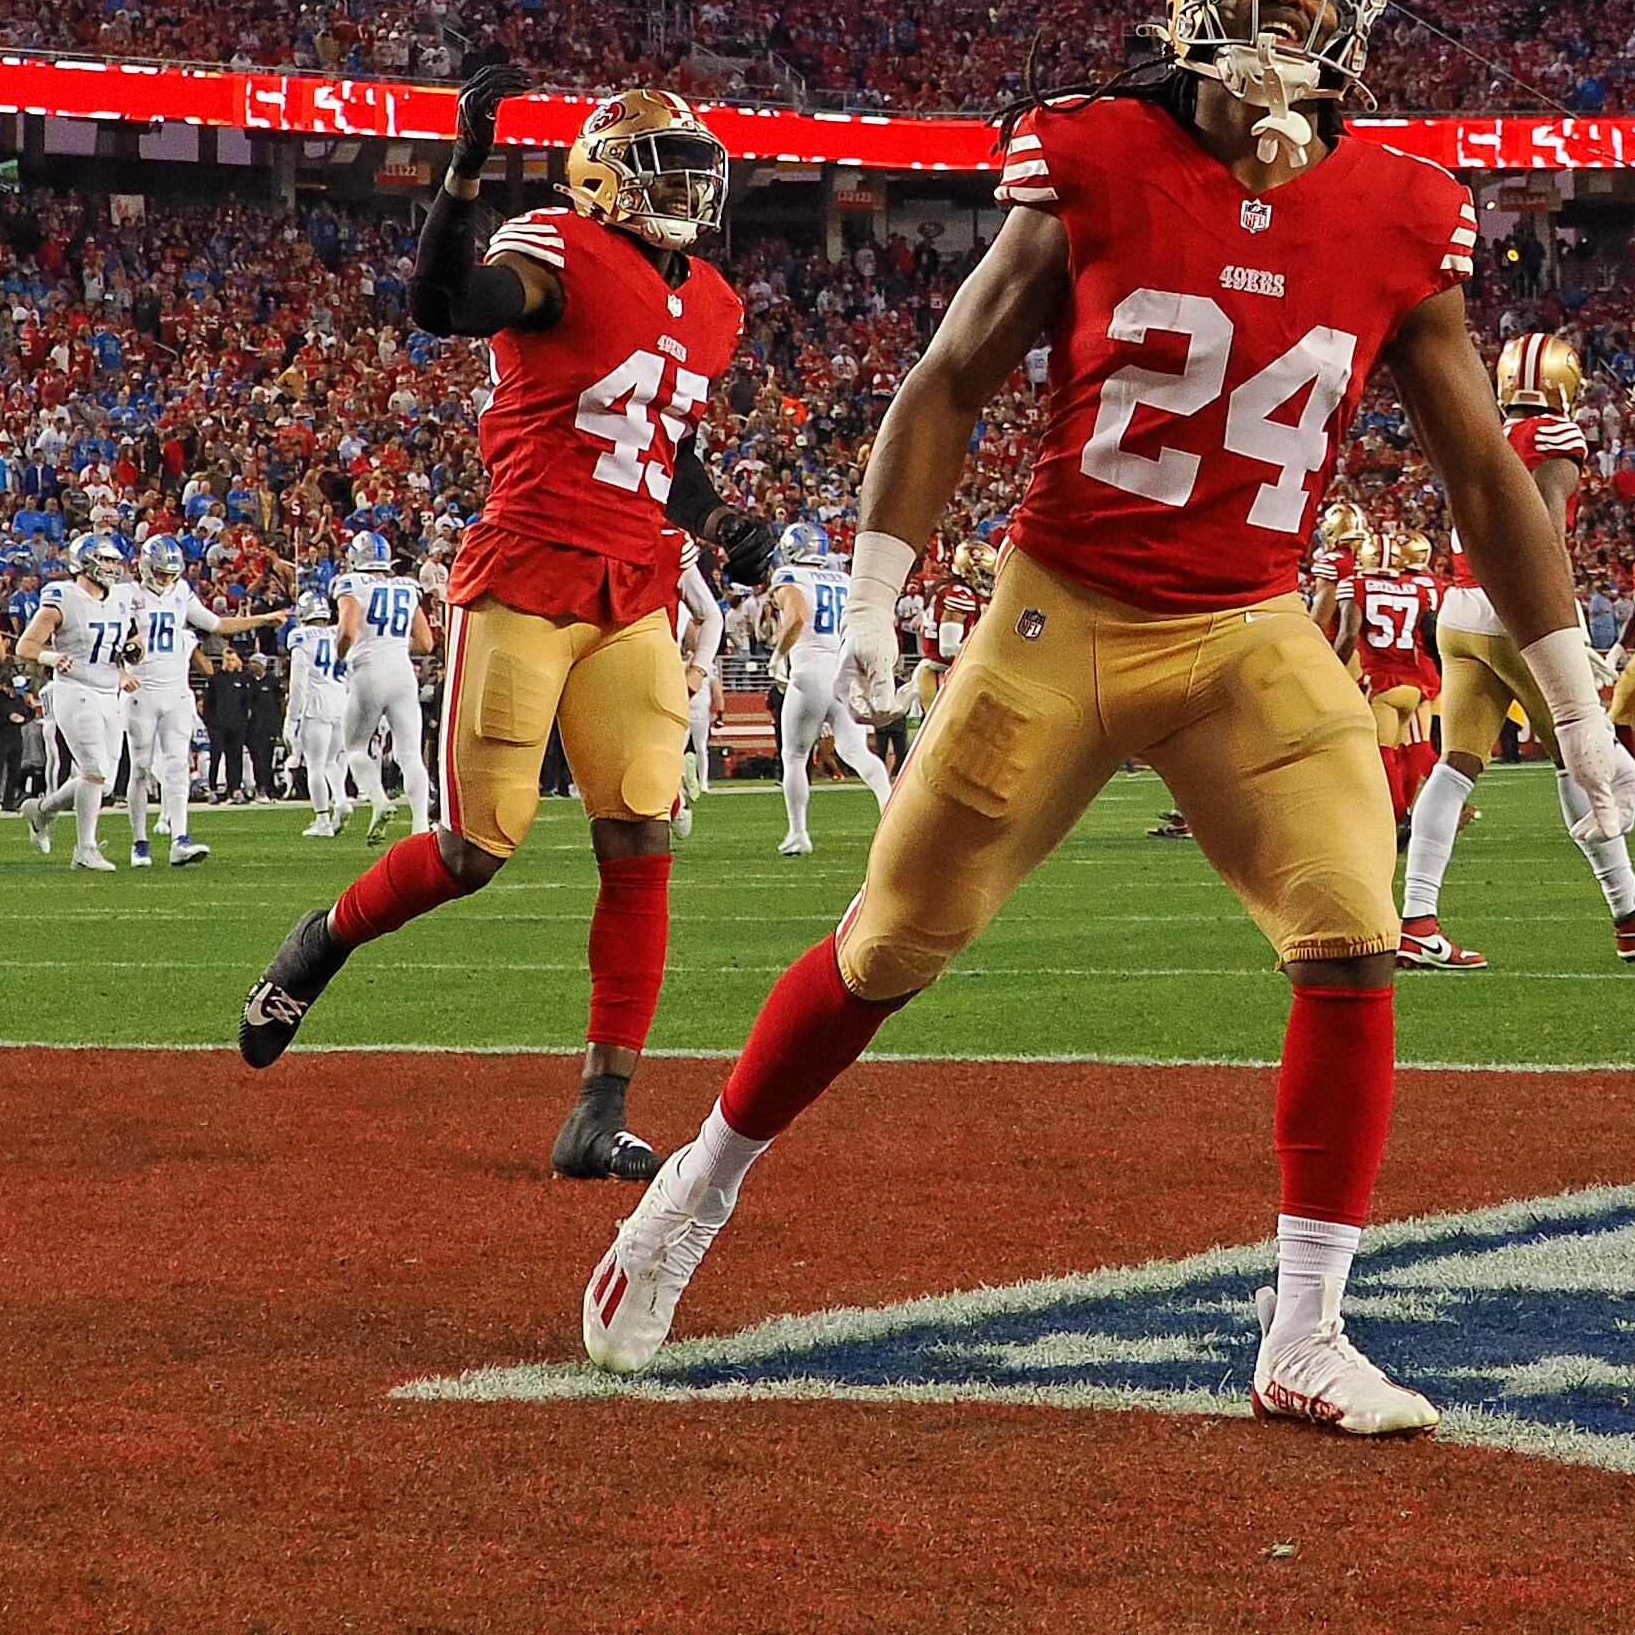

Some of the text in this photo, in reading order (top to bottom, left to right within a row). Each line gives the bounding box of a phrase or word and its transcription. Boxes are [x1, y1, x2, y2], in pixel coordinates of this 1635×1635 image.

[1219, 265, 1285, 297] 49ERS
[575, 350, 709, 505] 45
[1080, 288, 1357, 533] 24
[148, 611, 175, 653] 16
[366, 587, 410, 637] 46
[1366, 594, 1419, 649] 57
[88, 622, 122, 664] 77
